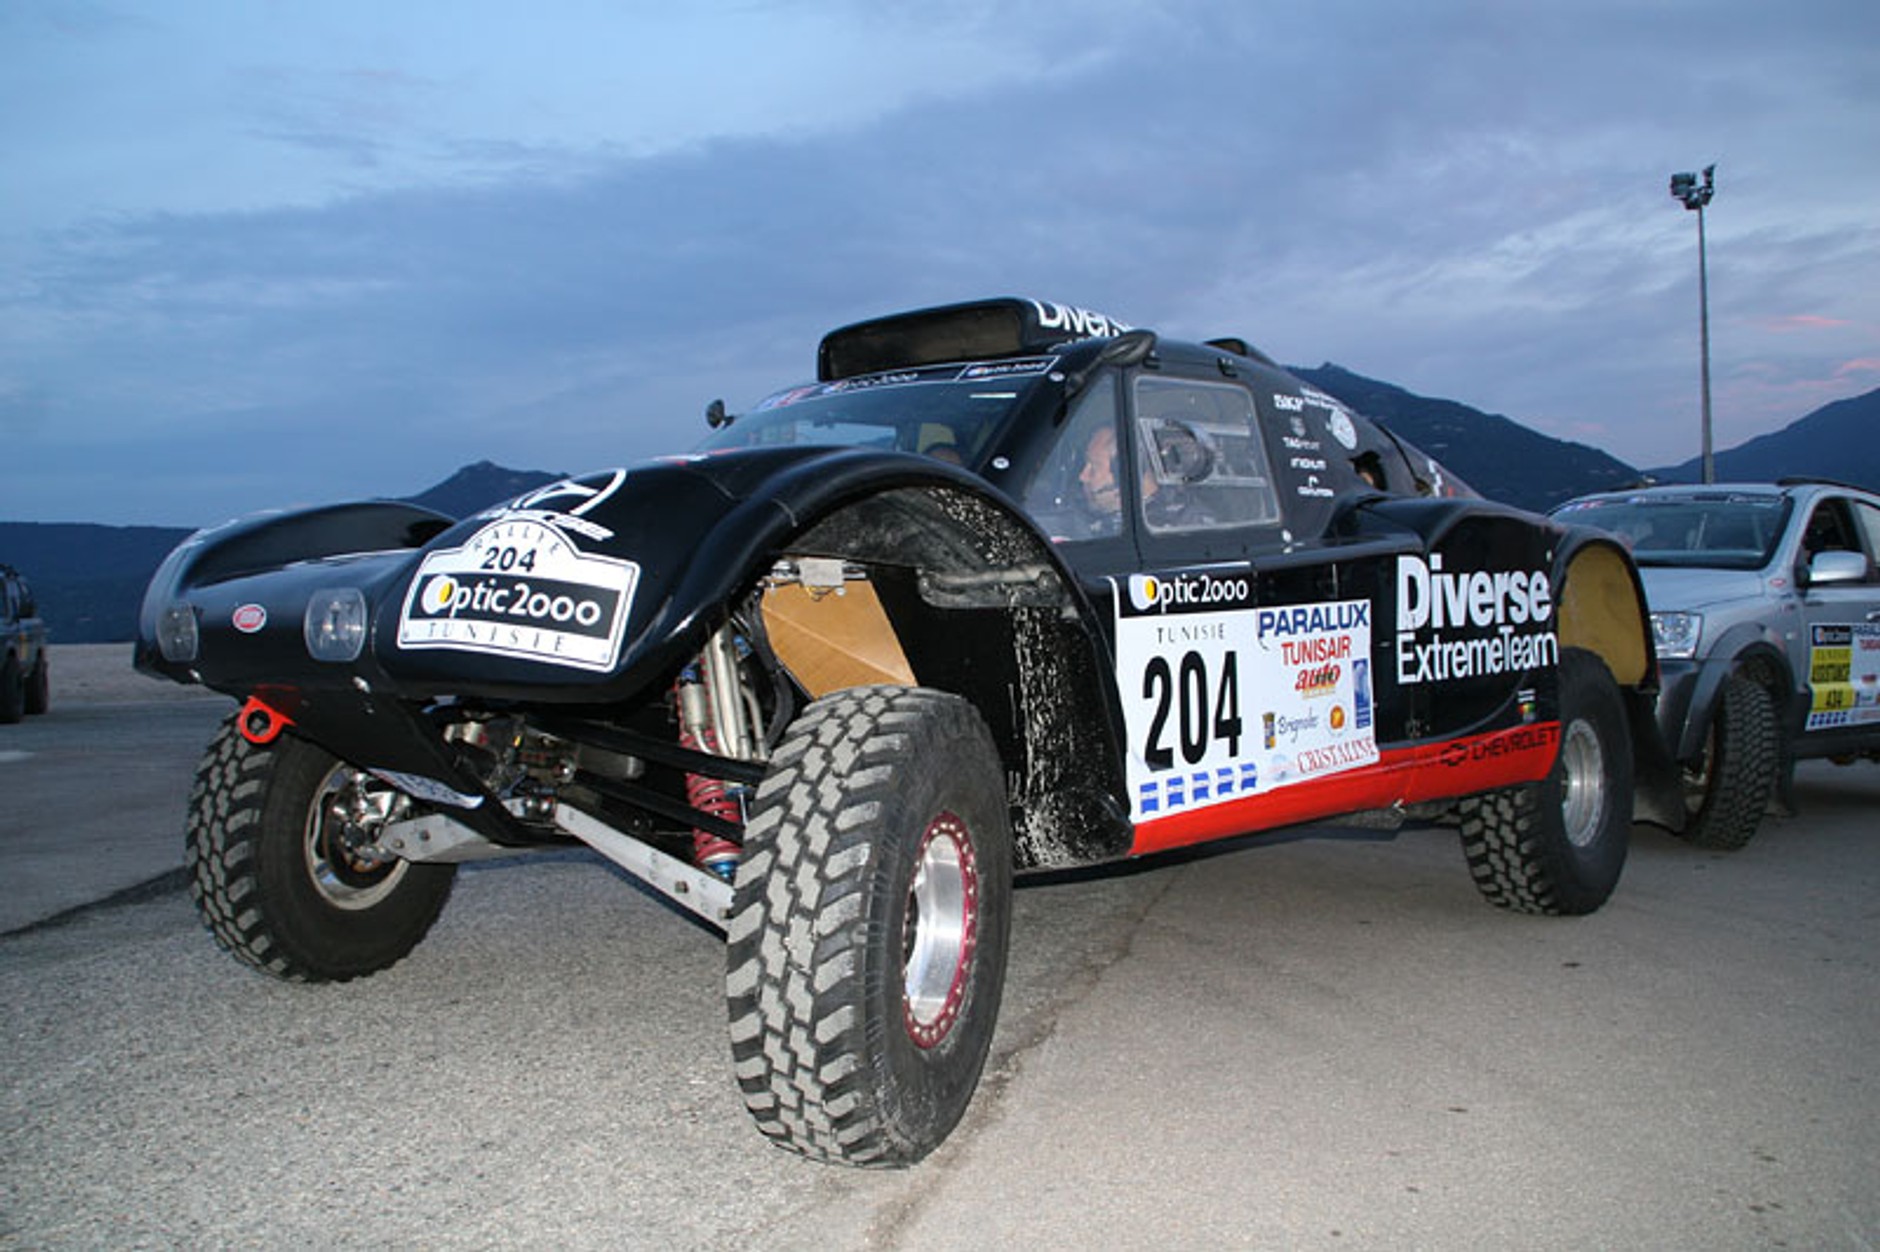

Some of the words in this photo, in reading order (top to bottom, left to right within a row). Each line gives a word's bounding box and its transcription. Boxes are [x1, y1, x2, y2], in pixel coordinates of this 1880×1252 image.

[480, 547, 538, 573] 204
[1396, 553, 1551, 632] Diverse
[1156, 622, 1226, 645] TUNISIE
[1258, 602, 1369, 639] PARALUX
[427, 622, 565, 653] TUNISIE
[1281, 635, 1352, 667] TUNISAIR
[1396, 624, 1560, 685] ExtremeTeam
[1295, 663, 1341, 691] auto
[1142, 650, 1243, 774] 204
